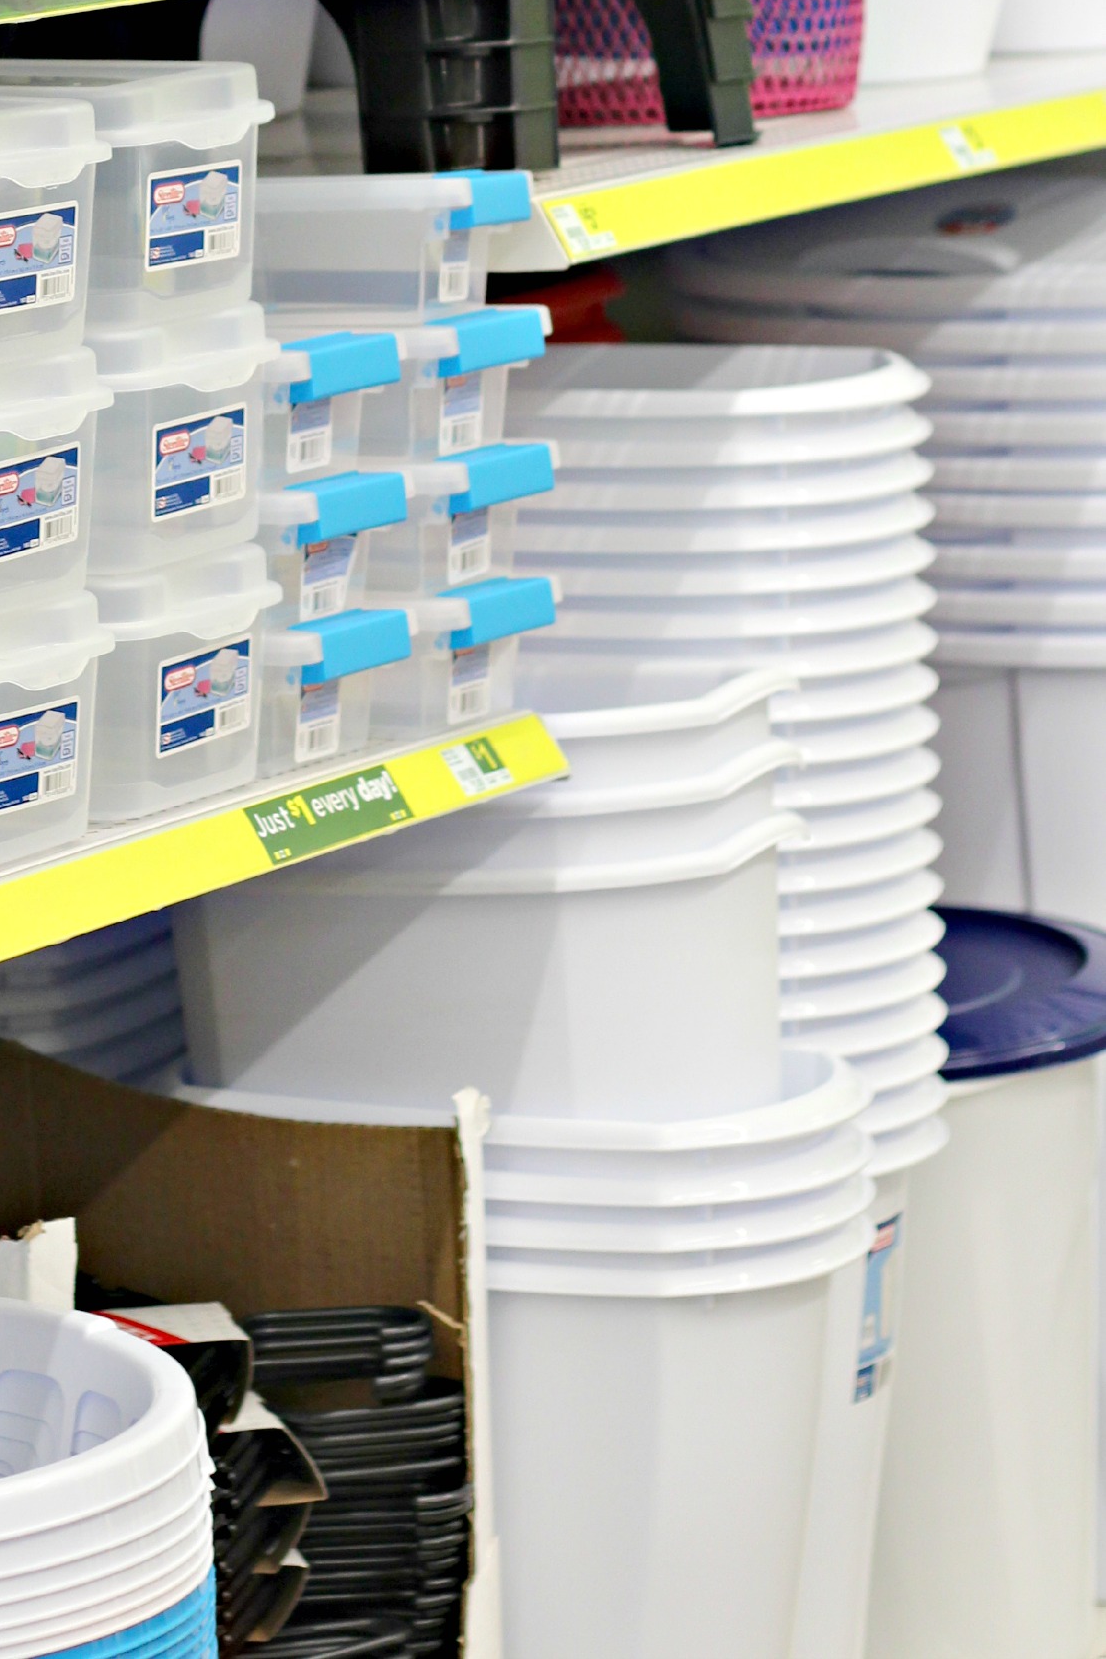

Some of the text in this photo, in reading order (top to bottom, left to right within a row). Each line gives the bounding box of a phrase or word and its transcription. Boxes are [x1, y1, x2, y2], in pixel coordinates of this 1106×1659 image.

[254, 770, 397, 838] Just $1 every day!
